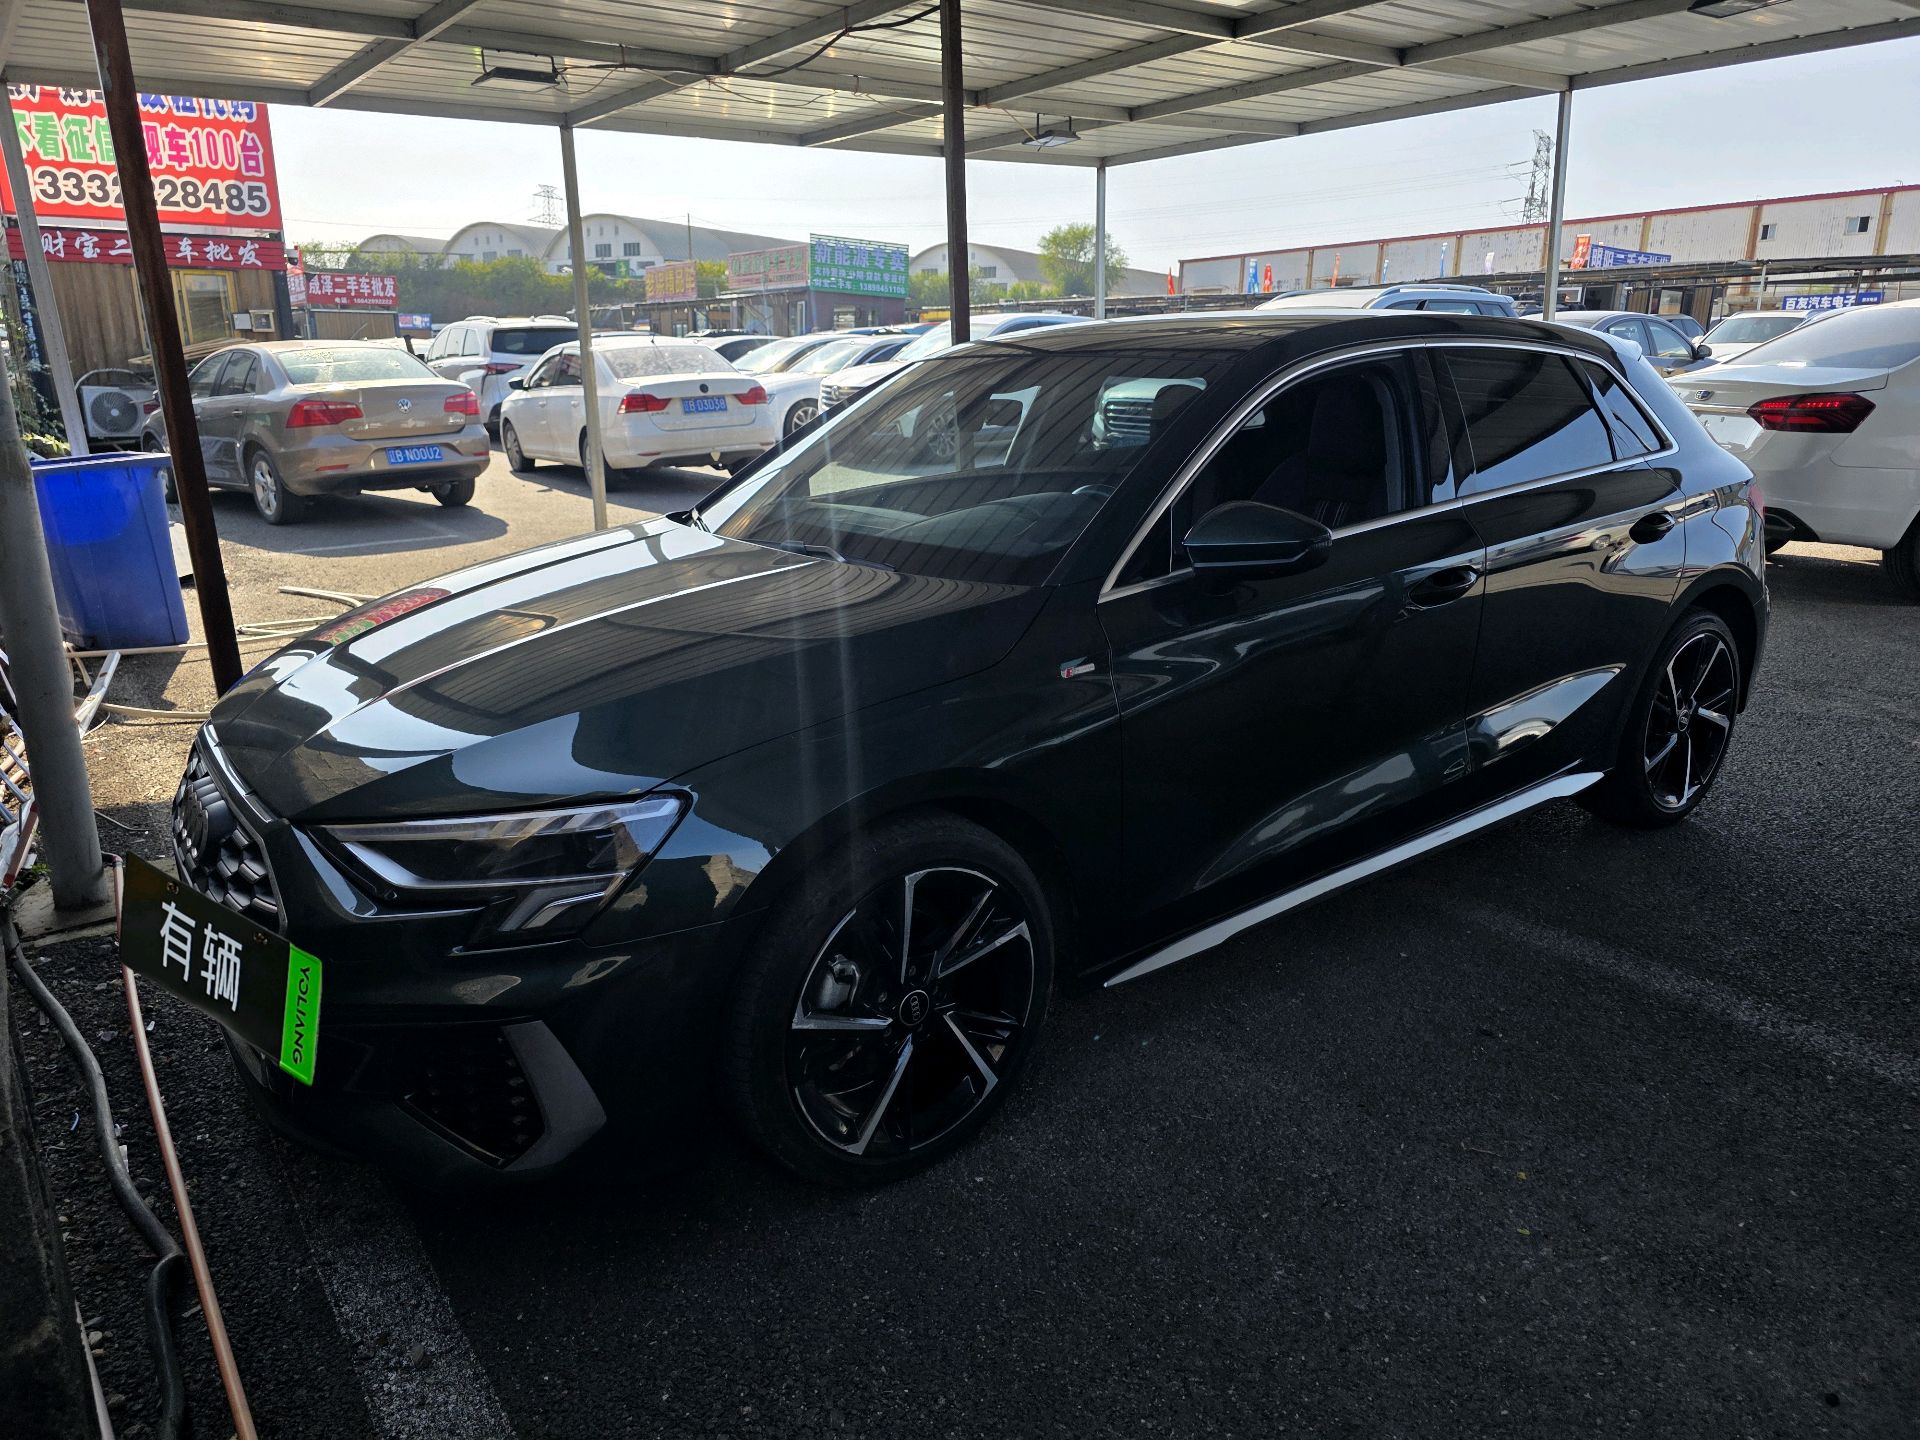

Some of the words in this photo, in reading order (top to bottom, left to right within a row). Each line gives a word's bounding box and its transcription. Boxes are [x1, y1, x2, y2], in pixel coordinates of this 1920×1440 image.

[41, 230, 263, 266] 财宝二车批发
[160, 901, 244, 1013] 有辆
[291, 966, 312, 1066] YOLIANG
